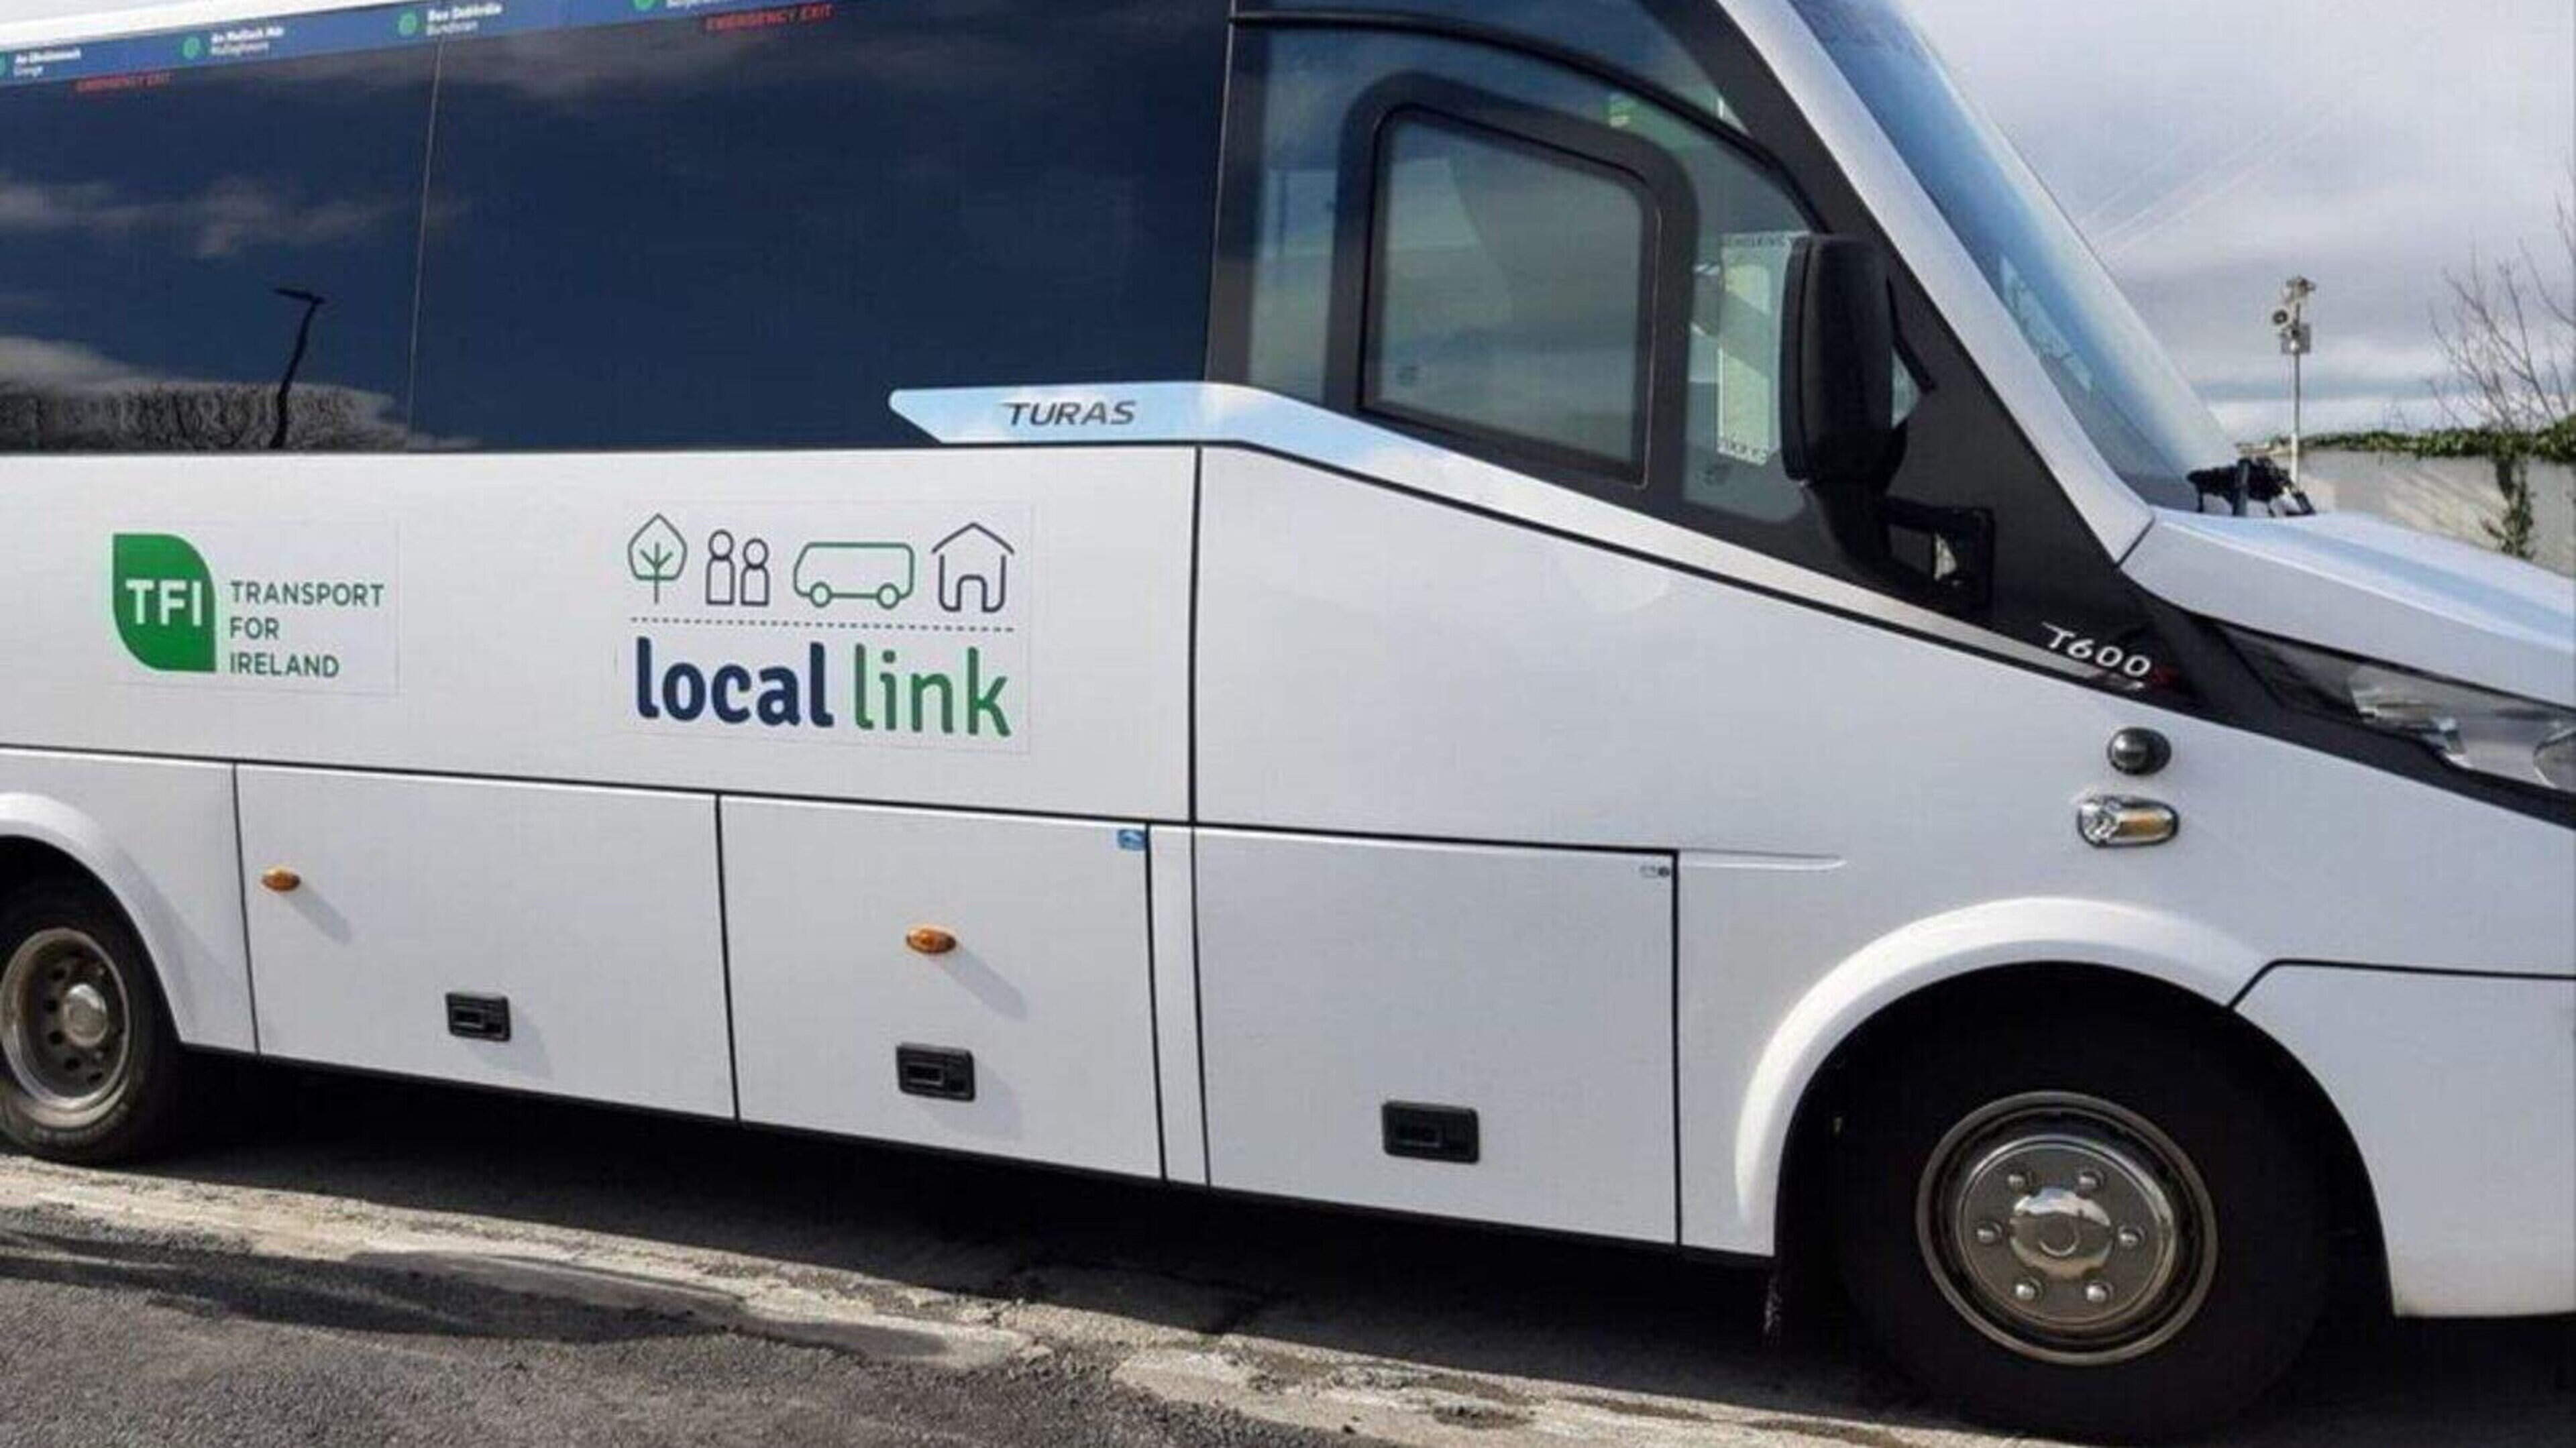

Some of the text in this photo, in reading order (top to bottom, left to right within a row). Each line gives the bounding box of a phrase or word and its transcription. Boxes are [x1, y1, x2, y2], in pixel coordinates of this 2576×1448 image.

[1000, 400, 1137, 426] TURAS
[125, 579, 202, 626] TFI
[230, 580, 385, 605] TRANSPORT
[230, 616, 280, 640] FOR
[230, 652, 340, 678] IRELAND
[636, 636, 1012, 737] local link
